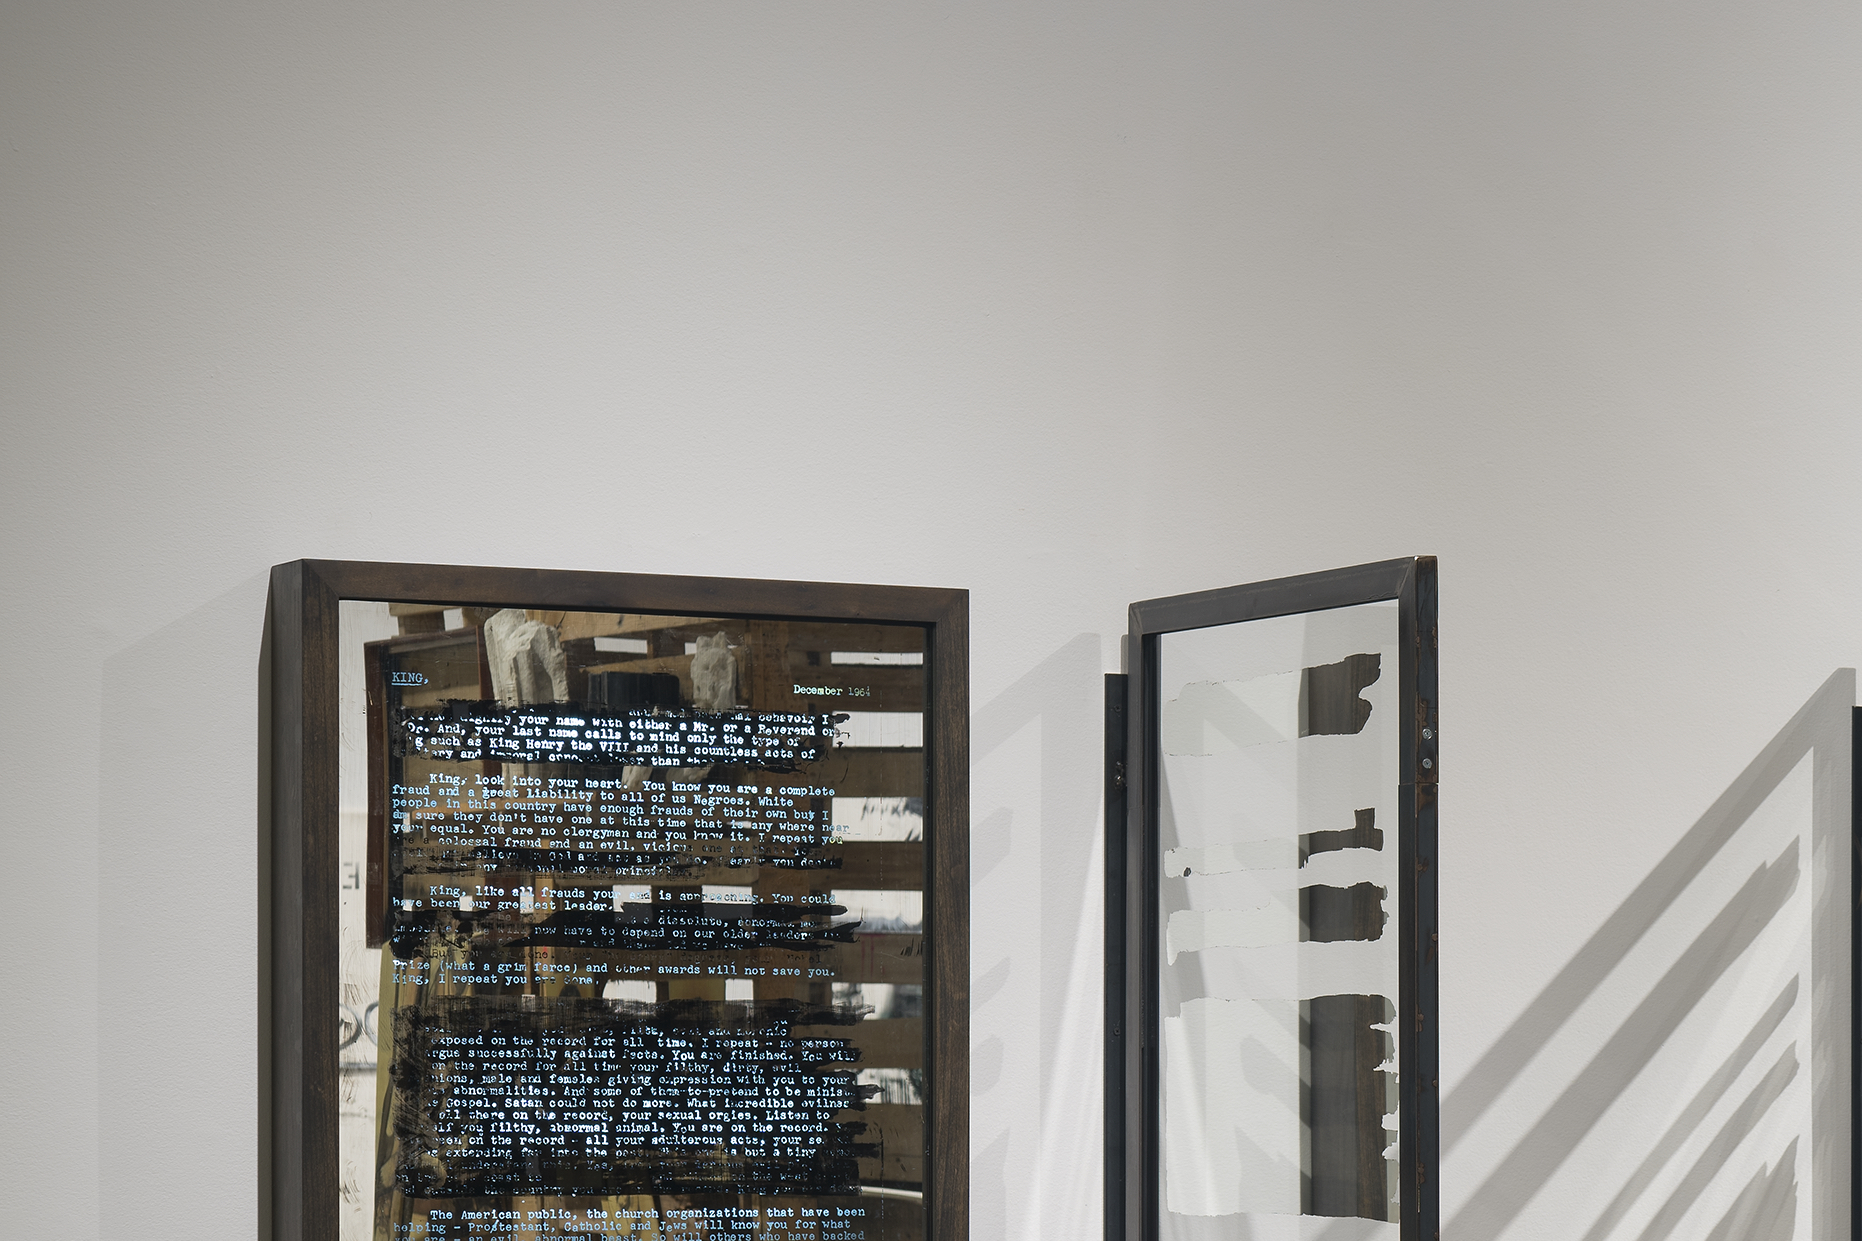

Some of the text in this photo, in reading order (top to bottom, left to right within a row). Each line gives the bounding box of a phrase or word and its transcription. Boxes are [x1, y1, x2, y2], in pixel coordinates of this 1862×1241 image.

[391, 672, 429, 686] KING,
[793, 685, 842, 696] December
[519, 715, 549, 728] your
[556, 716, 585, 726] name
[629, 719, 671, 731] either
[693, 721, 715, 732] Mr.
[758, 724, 815, 736] Reverend
[437, 724, 780, 748] And, your last name calls mind only the type
[430, 737, 816, 759] such King Henry the VIII and his countless of
[652, 755, 680, 766] than
[475, 774, 835, 797] look into your heart. You know you complete
[392, 784, 793, 807] fraud and all Negroes. White
[392, 798, 758, 818] people this country have enough frauds their
[415, 810, 815, 831] sure they don't have this time that where
[430, 824, 814, 844] equal. You are and you repeat
[429, 886, 585, 898] King, like all frauds
[392, 959, 835, 977] Prize (what grim farce) and awards will not save you.
[392, 974, 526, 986] King, repeat you
[468, 1049, 793, 1061] successfully against finished.
[505, 1099, 543, 1108] Satan
[708, 1110, 809, 1121] orgies. Listen
[490, 1122, 540, 1134] filthy,
[780, 1123, 828, 1132] record.
[430, 1207, 865, 1221] The American public, the church organizations that have been
[393, 1220, 851, 1233] helping Catholic and Jews will know you what
[651, 1232, 666, 1241] So
[673, 1232, 702, 1241] will
[709, 1232, 751, 1241] others
[823, 1230, 865, 1240] backed
